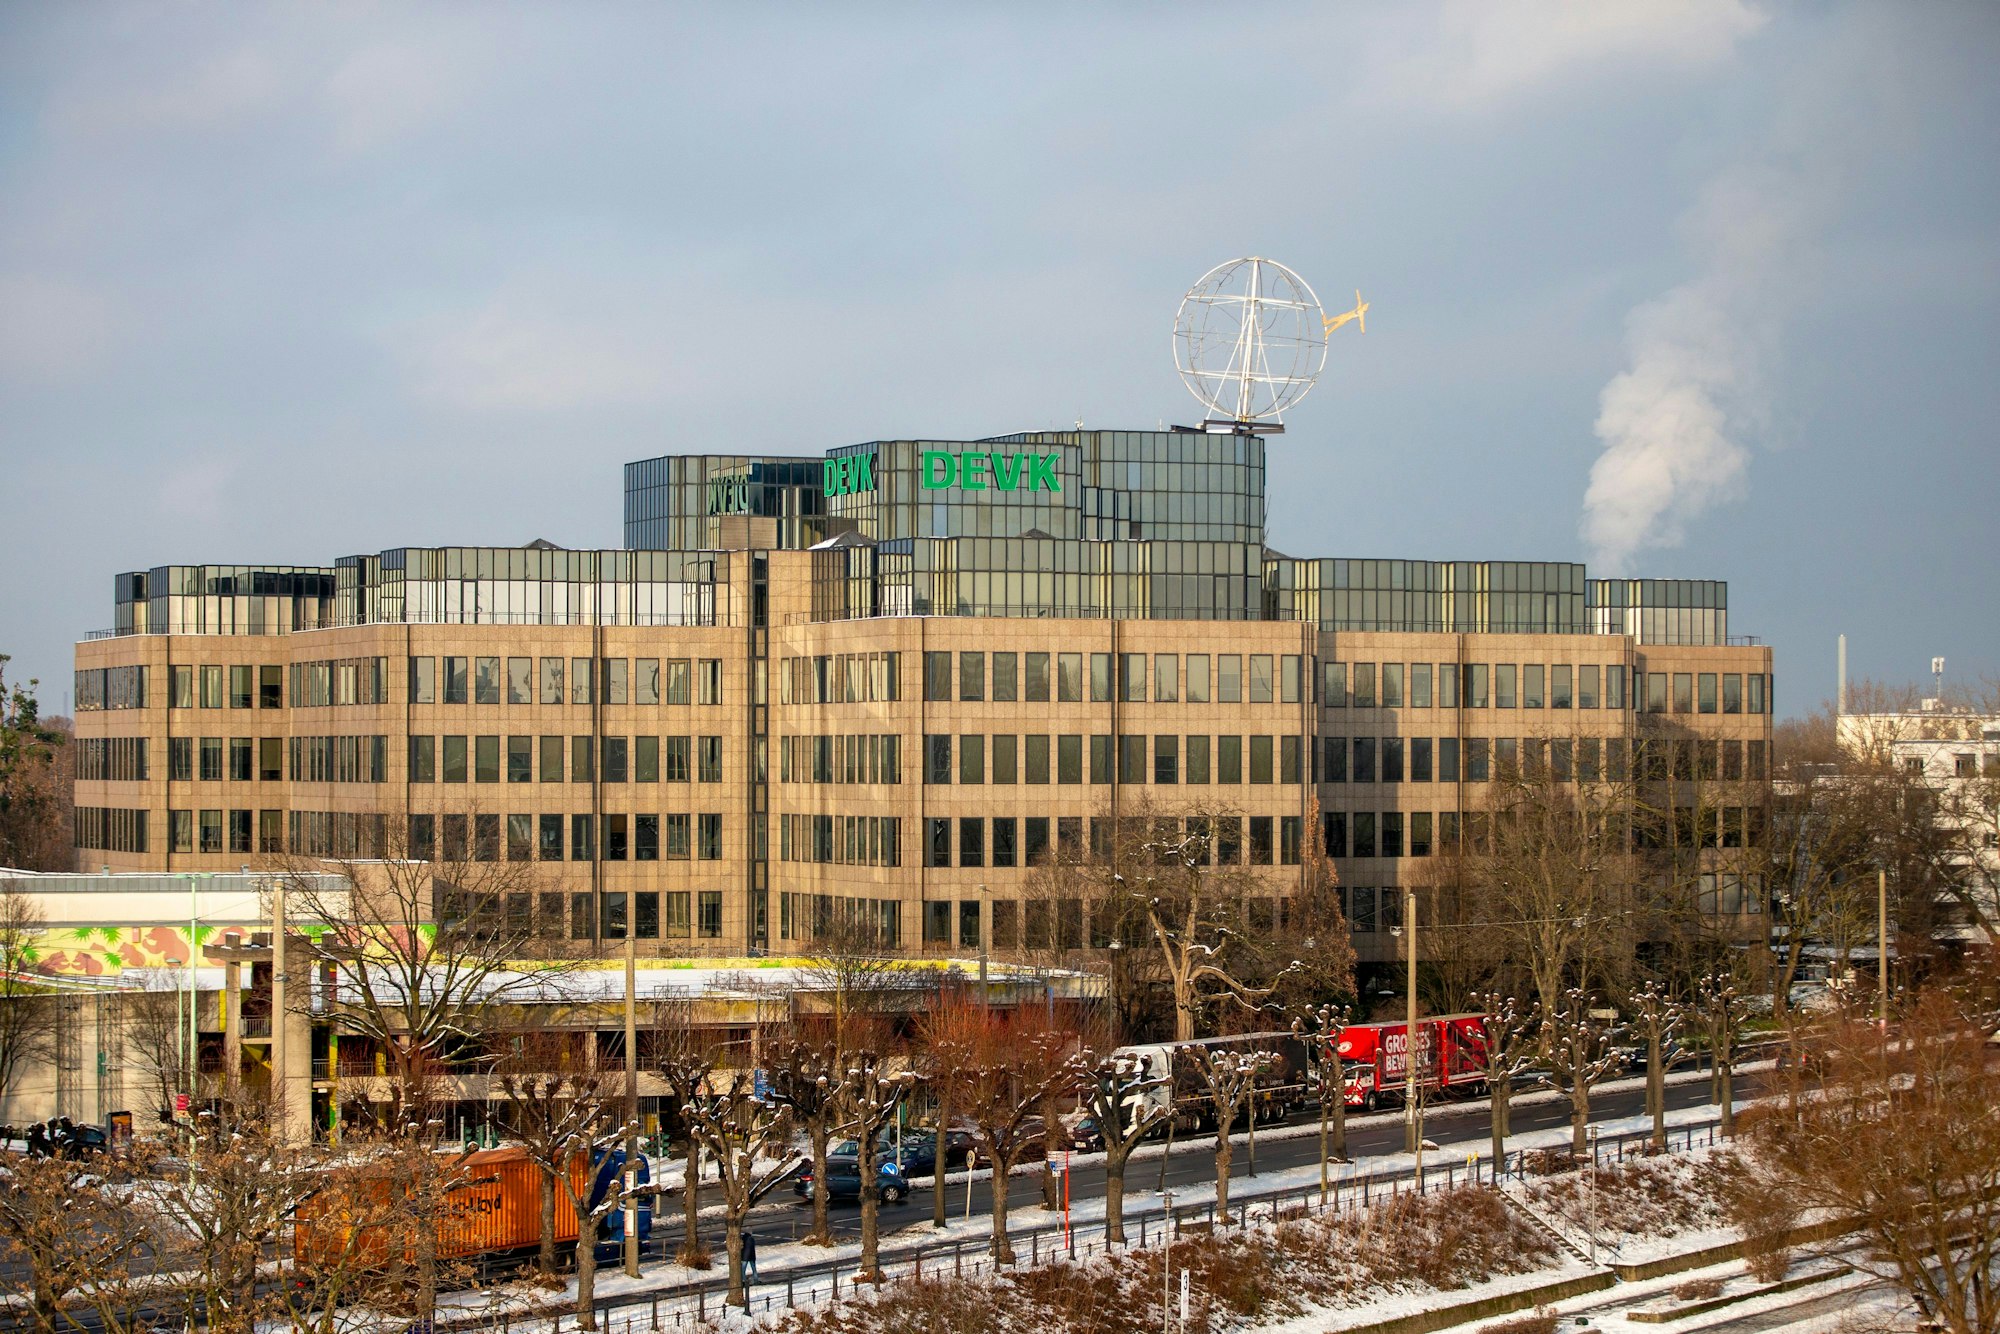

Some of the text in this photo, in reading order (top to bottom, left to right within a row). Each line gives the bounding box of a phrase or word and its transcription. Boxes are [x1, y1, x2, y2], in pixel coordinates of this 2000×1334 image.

[824, 452, 874, 498] DEVK
[922, 450, 1062, 492] DEVK
[1183, 1275, 1188, 1290] 3
